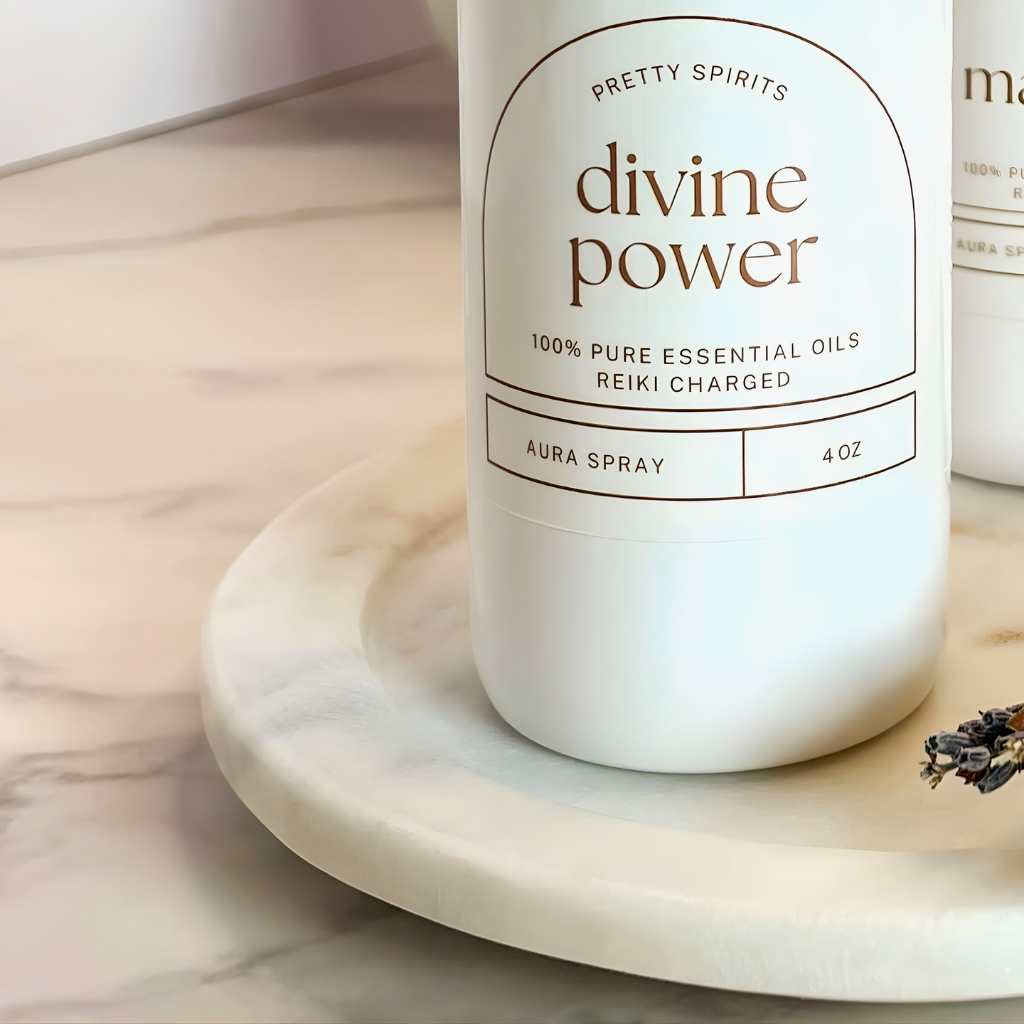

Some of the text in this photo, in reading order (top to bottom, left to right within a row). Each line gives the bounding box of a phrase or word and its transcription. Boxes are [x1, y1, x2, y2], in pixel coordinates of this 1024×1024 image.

[592, 63, 788, 102] PRETTY SPIRITS
[576, 141, 808, 217] divine
[962, 161, 1002, 178] 100%
[957, 238, 998, 255] AURA
[569, 235, 819, 307] power
[532, 331, 861, 366] 100% PURE ESSENTIAL OILS
[597, 370, 791, 394] REIKI CHARGED
[526, 438, 664, 475] AURA SPRAY
